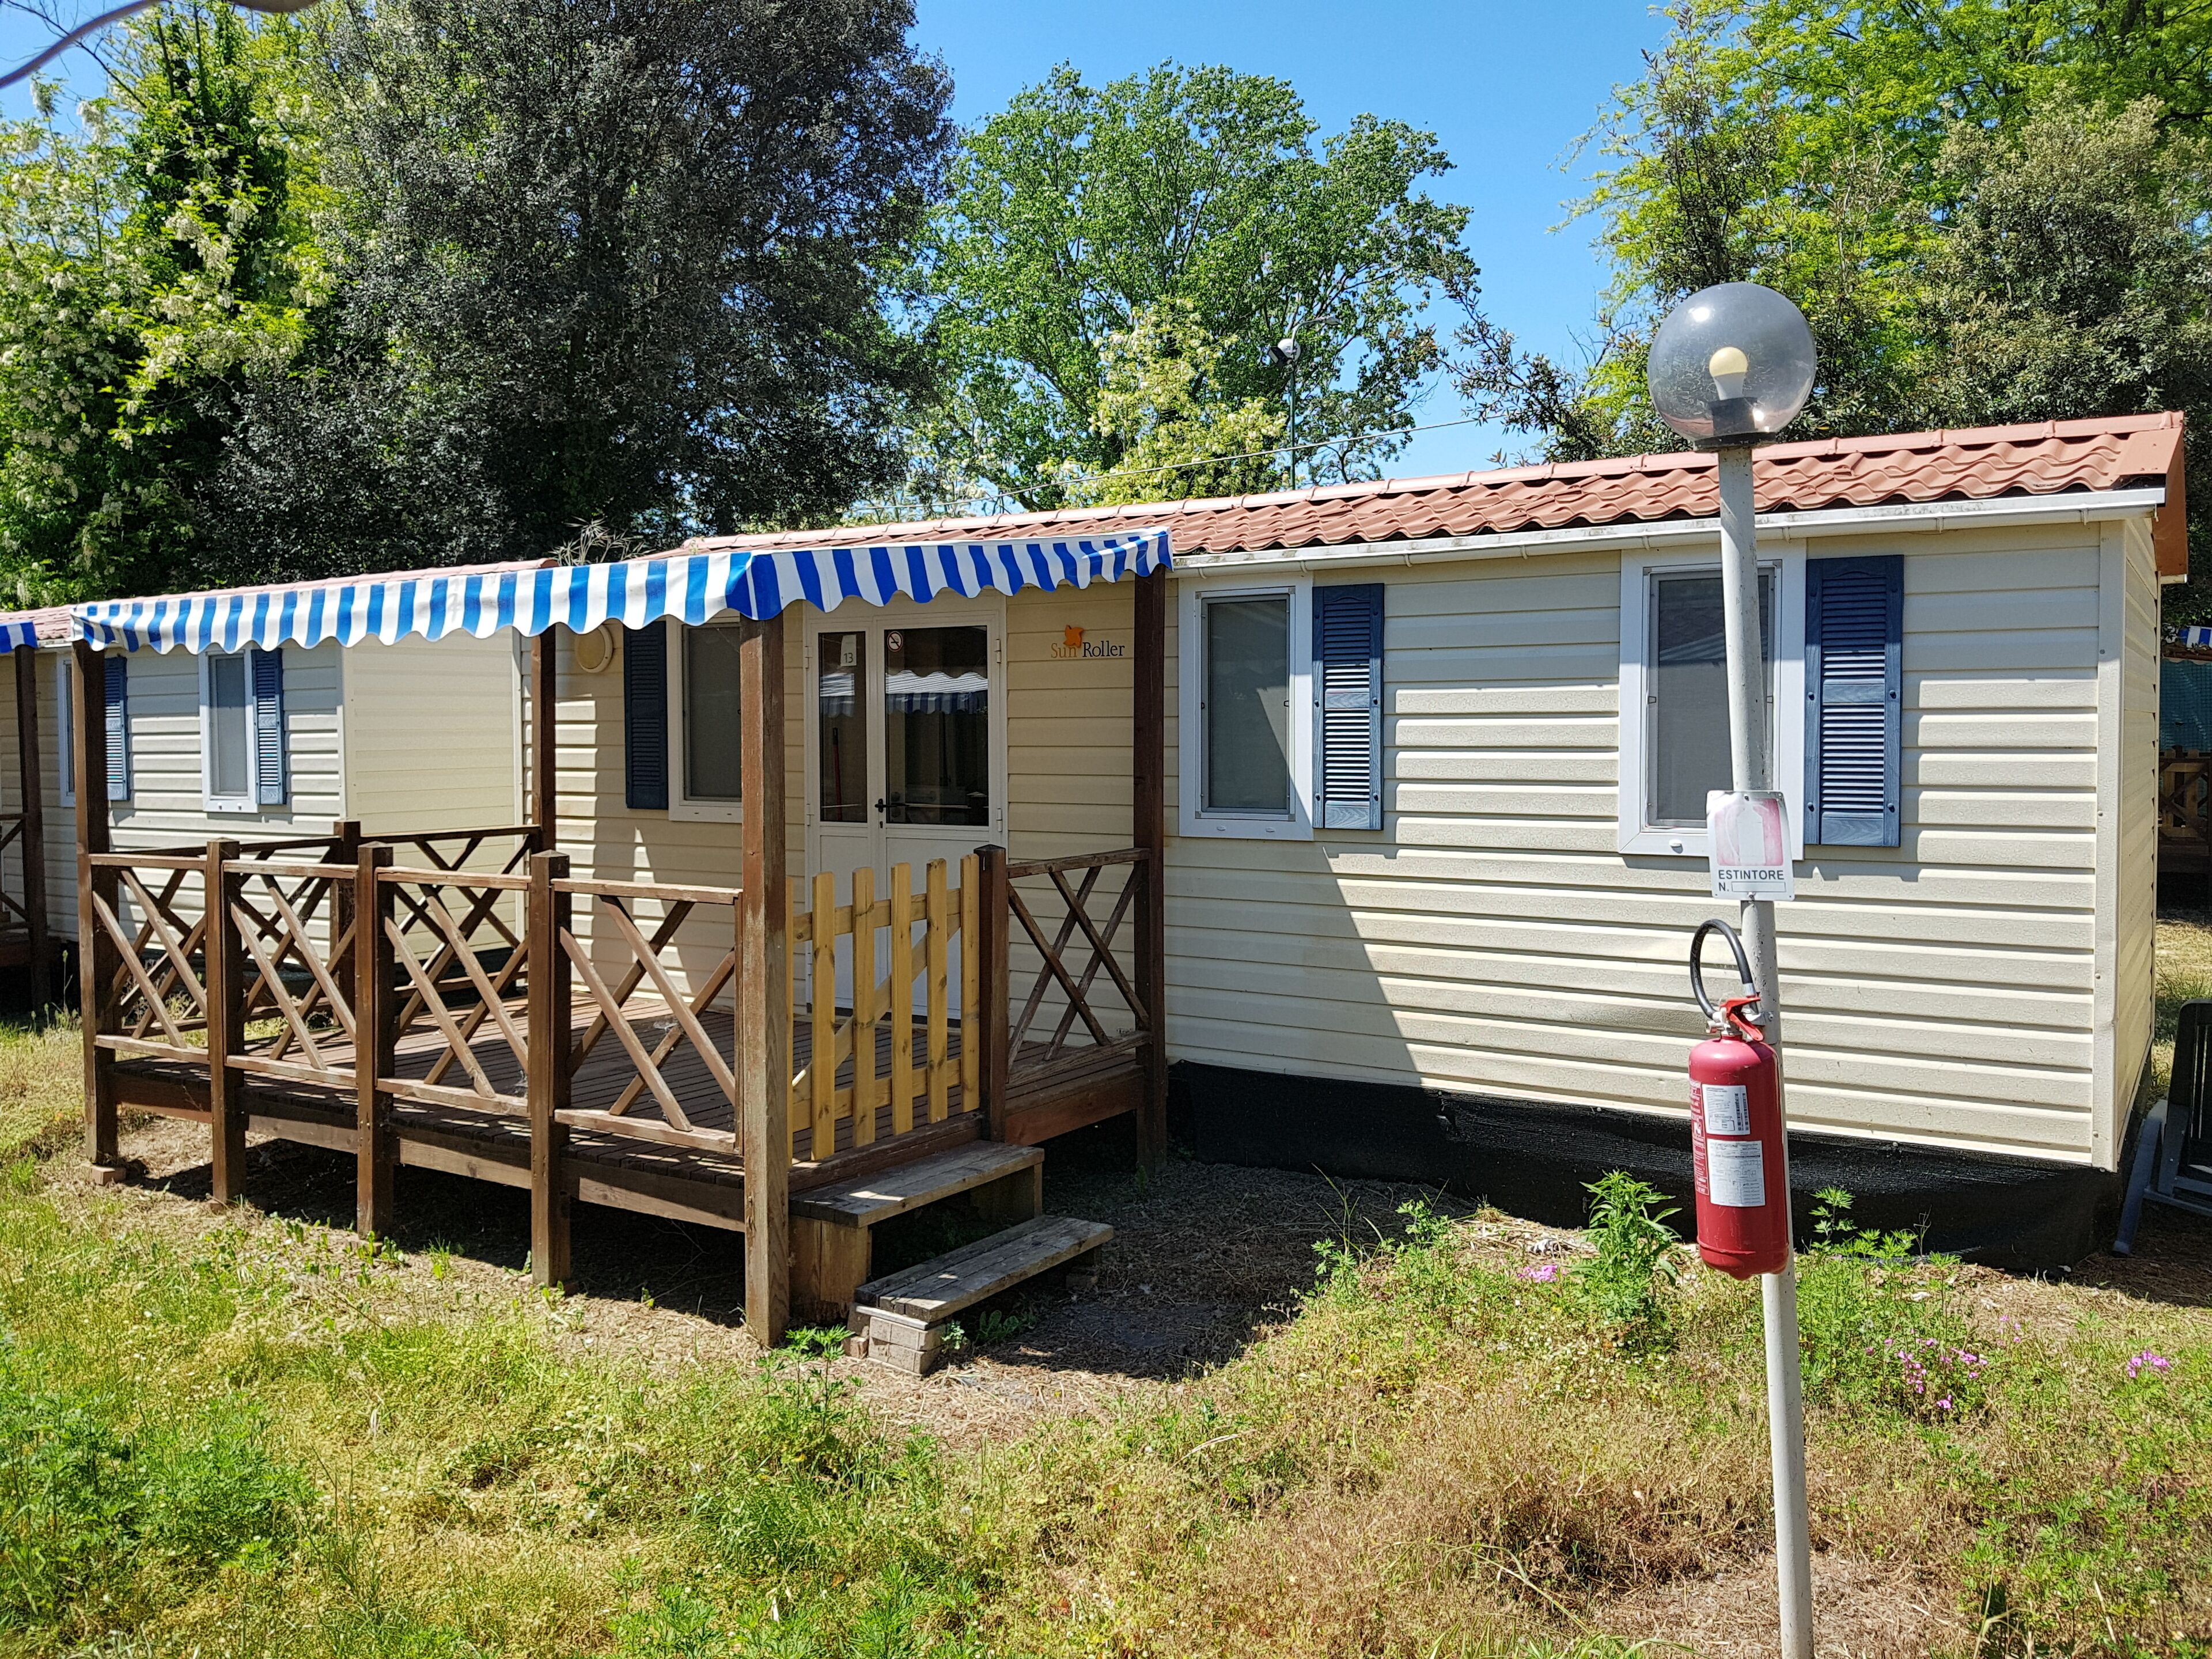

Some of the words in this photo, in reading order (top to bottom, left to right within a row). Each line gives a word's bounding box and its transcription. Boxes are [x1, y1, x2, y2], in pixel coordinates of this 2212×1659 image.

[1050, 642, 1077, 658] Sun
[1082, 641, 1125, 657] Roller
[843, 652, 854, 664] 13
[1718, 870, 1785, 880] ESTINTORE
[1718, 882, 1729, 892] N.
